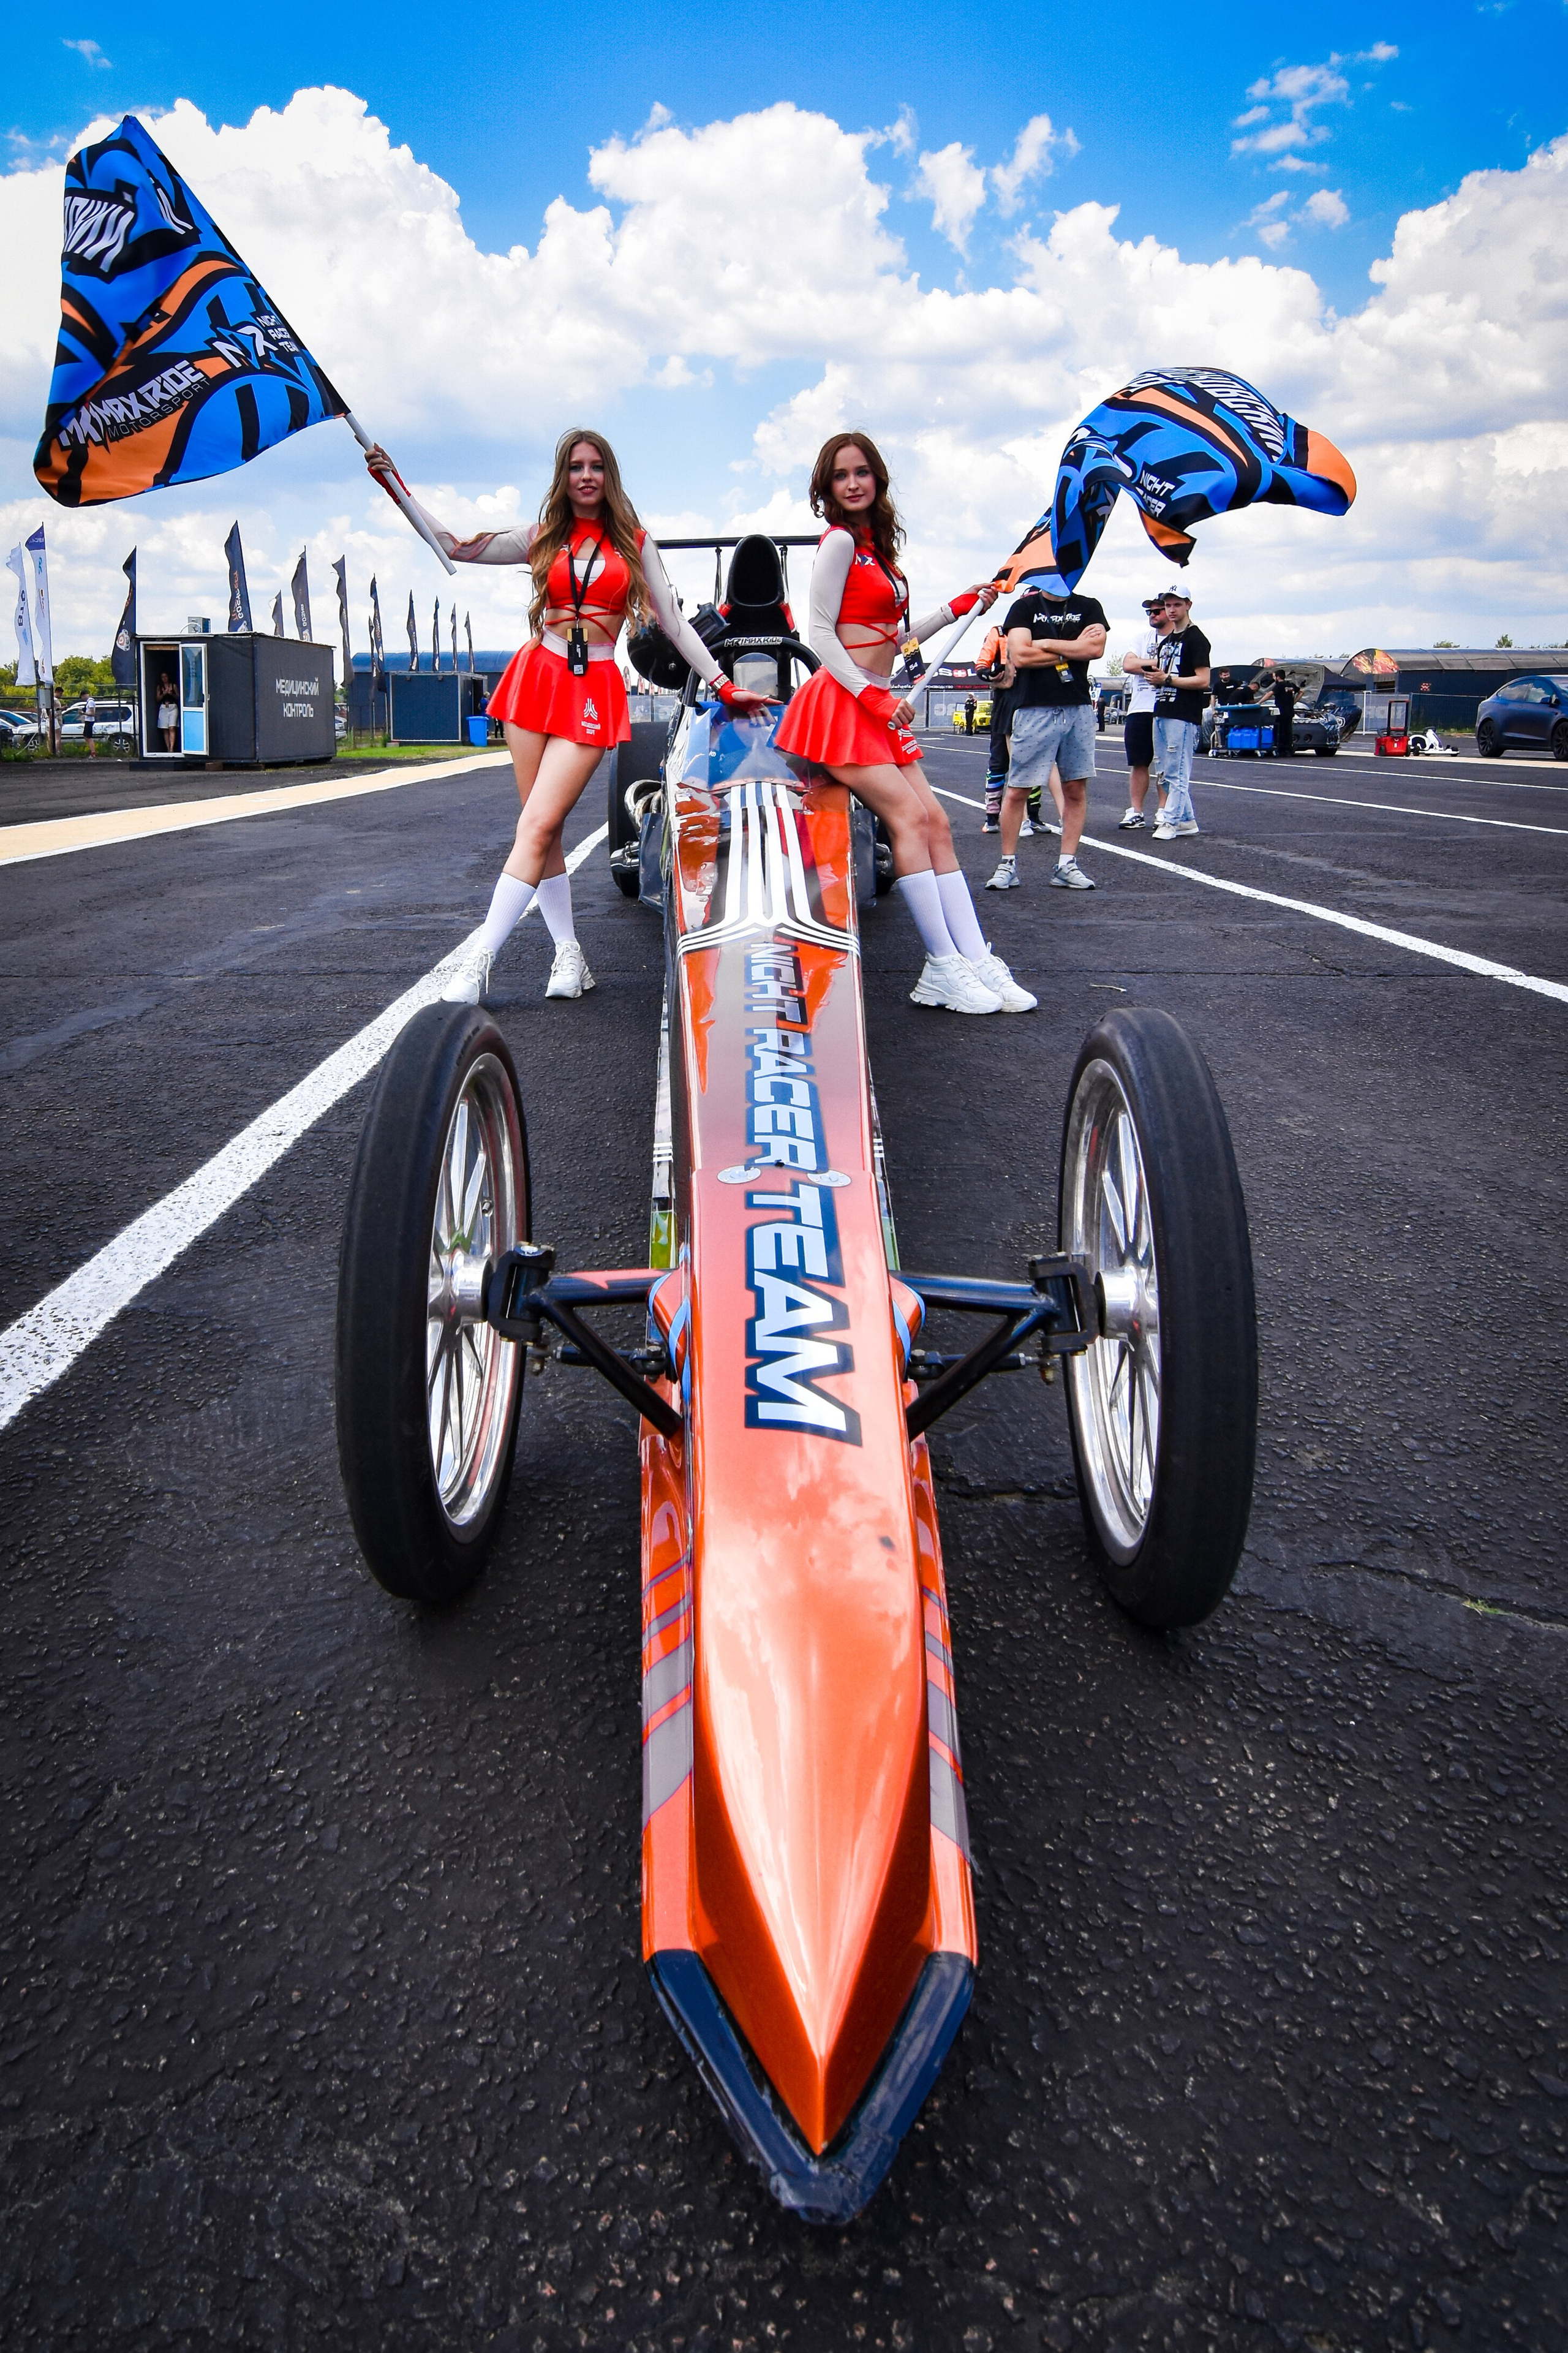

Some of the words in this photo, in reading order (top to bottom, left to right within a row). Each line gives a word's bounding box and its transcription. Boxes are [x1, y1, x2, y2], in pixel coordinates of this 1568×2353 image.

[108, 377, 210, 439] MOTORSPORT
[1139, 469, 1176, 497] NIGHT
[276, 677, 319, 697] МЕДИЦИНСКИЙ
[909, 662, 918, 671] 54
[283, 703, 314, 717] КОНТРОЛЬ
[749, 942, 802, 1024] NIGHT
[752, 1027, 819, 1172] RACER
[751, 1182, 849, 1433] TEAM
